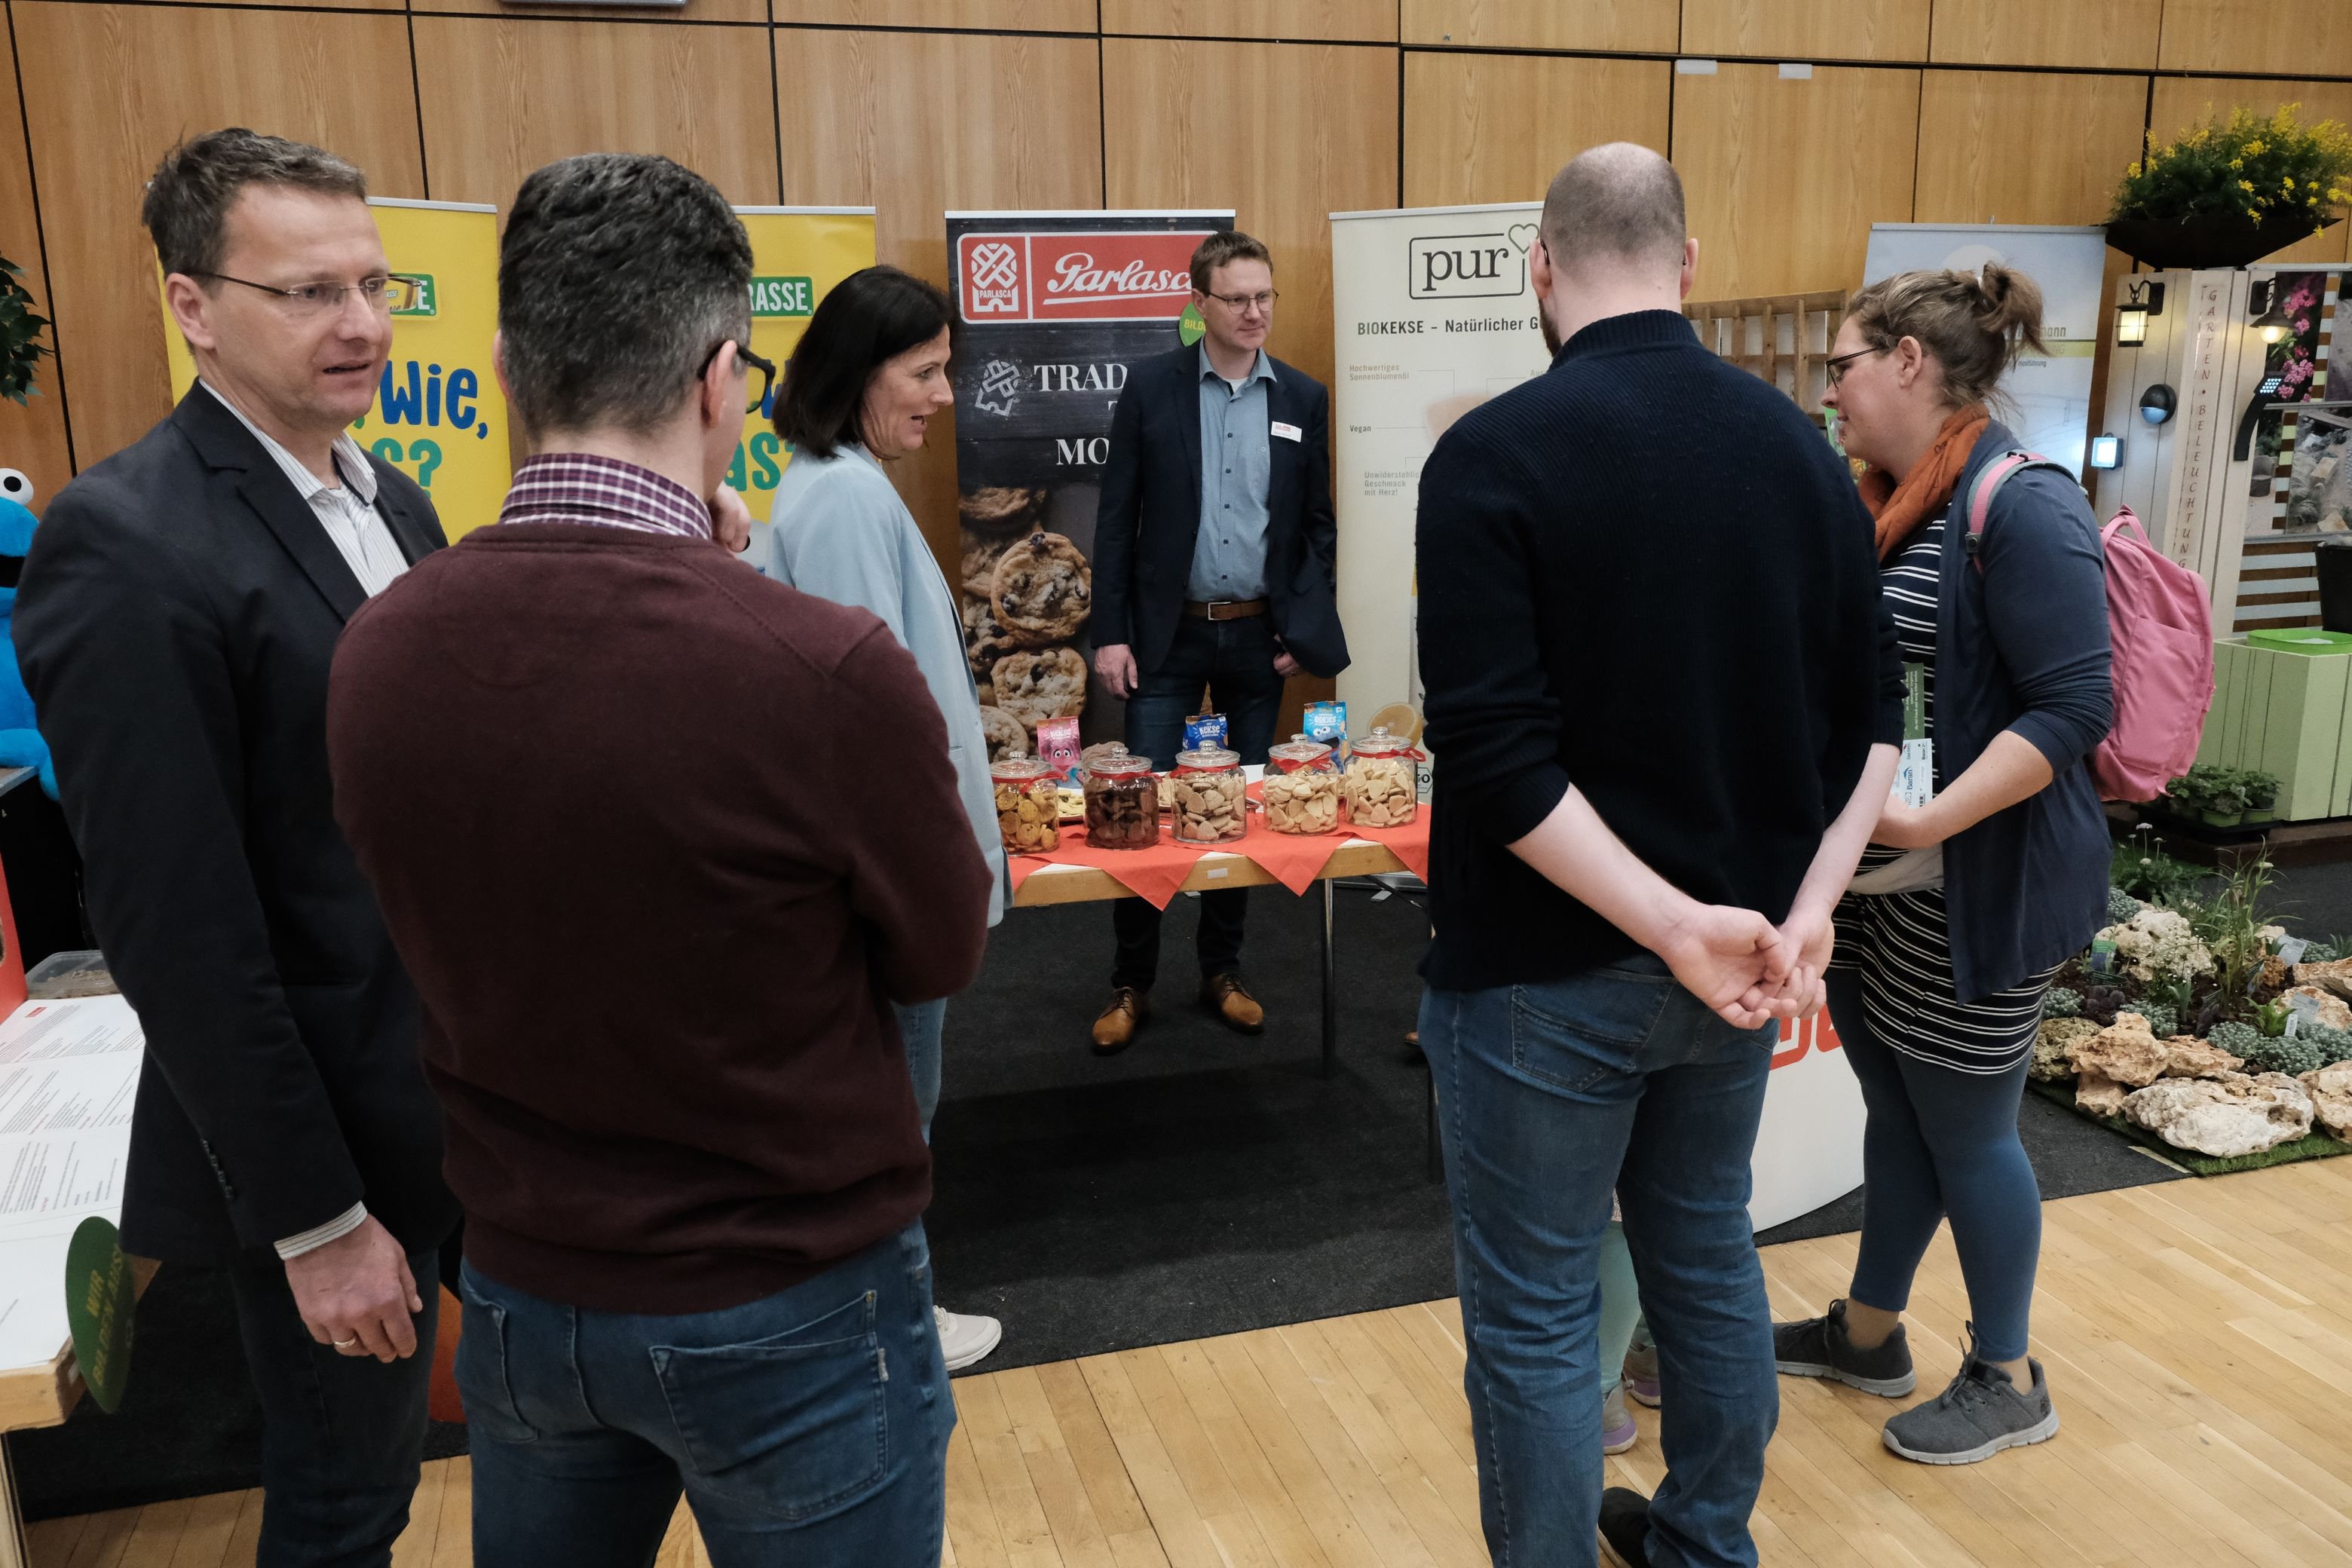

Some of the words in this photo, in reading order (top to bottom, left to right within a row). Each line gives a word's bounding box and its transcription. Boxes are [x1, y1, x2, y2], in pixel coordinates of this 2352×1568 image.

[1422, 247, 1509, 292] pur
[979, 289, 1012, 299] PARLASCA
[1358, 320, 1424, 335] BIOKEKSE
[1444, 318, 1524, 332] Natürlicher
[2200, 289, 2217, 380] GARTEN
[1349, 364, 1400, 373] Hochwertiges
[1349, 372, 1410, 381] Sonnenblumenöl
[379, 360, 488, 439] Wie,
[1349, 424, 1371, 433] Vegan
[1364, 471, 1421, 479] Unwiderstehlic
[1364, 479, 1407, 488] Geschmack
[2177, 404, 2207, 569] BELEUCHTUNG
